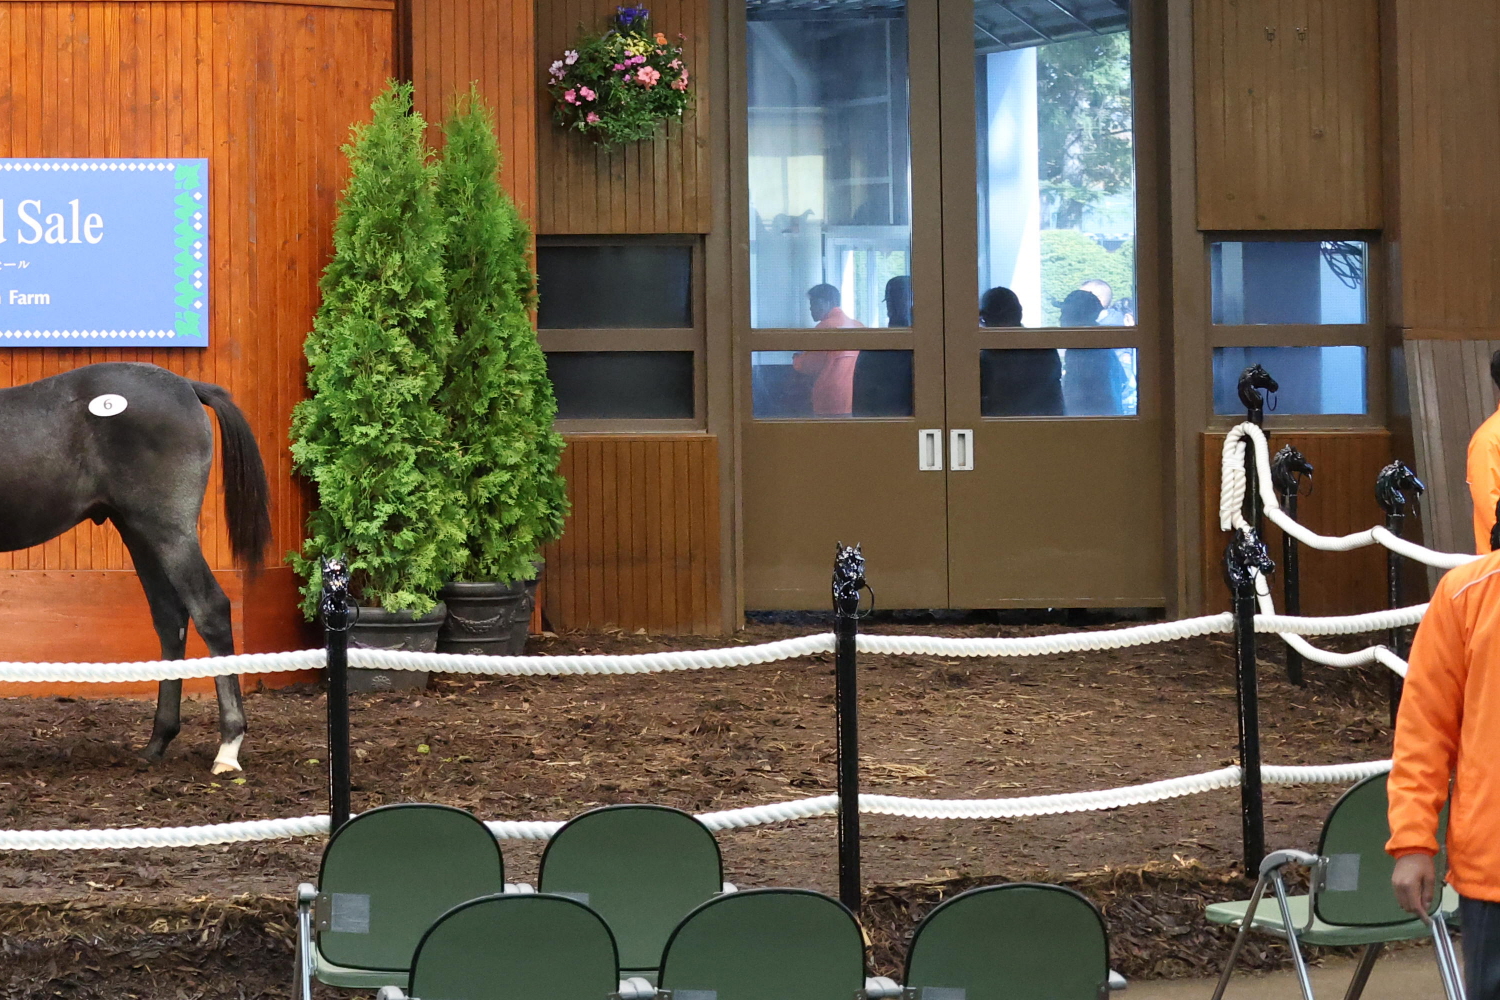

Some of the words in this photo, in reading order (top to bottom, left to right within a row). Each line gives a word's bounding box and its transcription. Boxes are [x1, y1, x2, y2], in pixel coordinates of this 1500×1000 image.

[17, 198, 104, 245] Sale
[9, 289, 51, 306] Farm
[103, 398, 113, 410] 6
